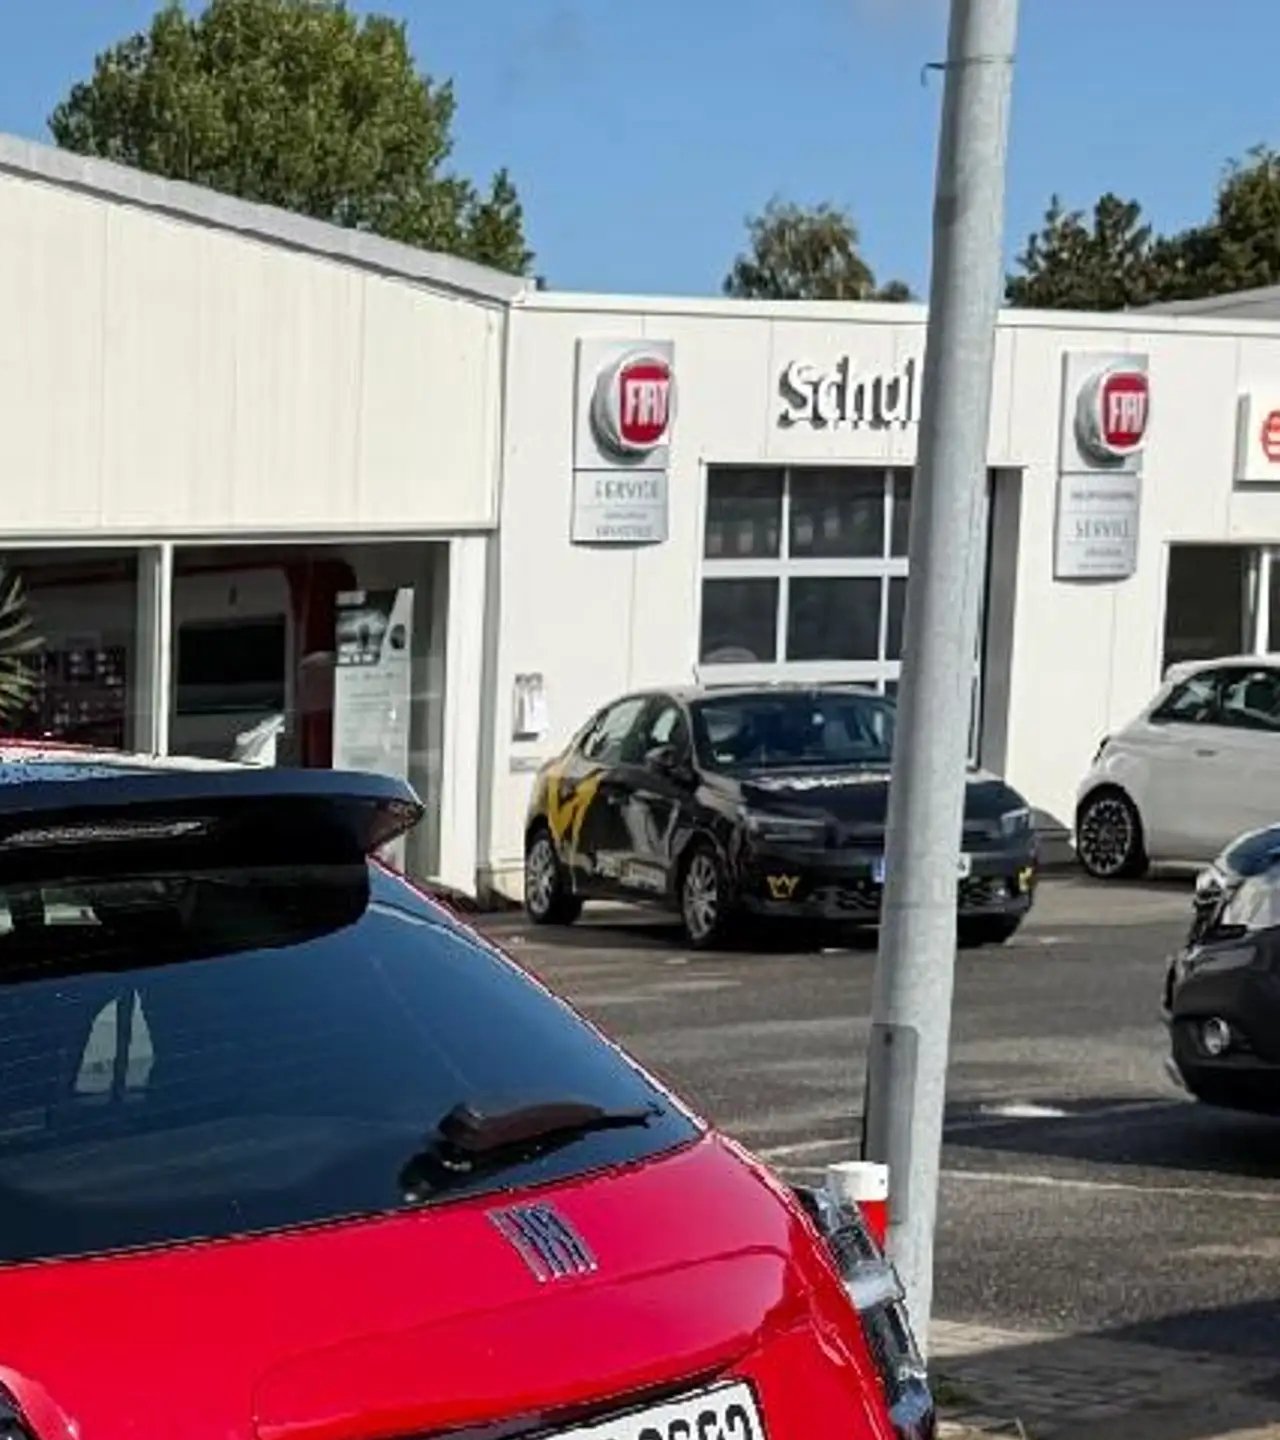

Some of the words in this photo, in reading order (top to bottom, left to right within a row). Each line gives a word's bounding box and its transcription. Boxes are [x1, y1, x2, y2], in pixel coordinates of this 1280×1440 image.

[625, 379, 669, 426] FIAT
[787, 354, 922, 420] Schul
[1109, 391, 1146, 434] FIAT
